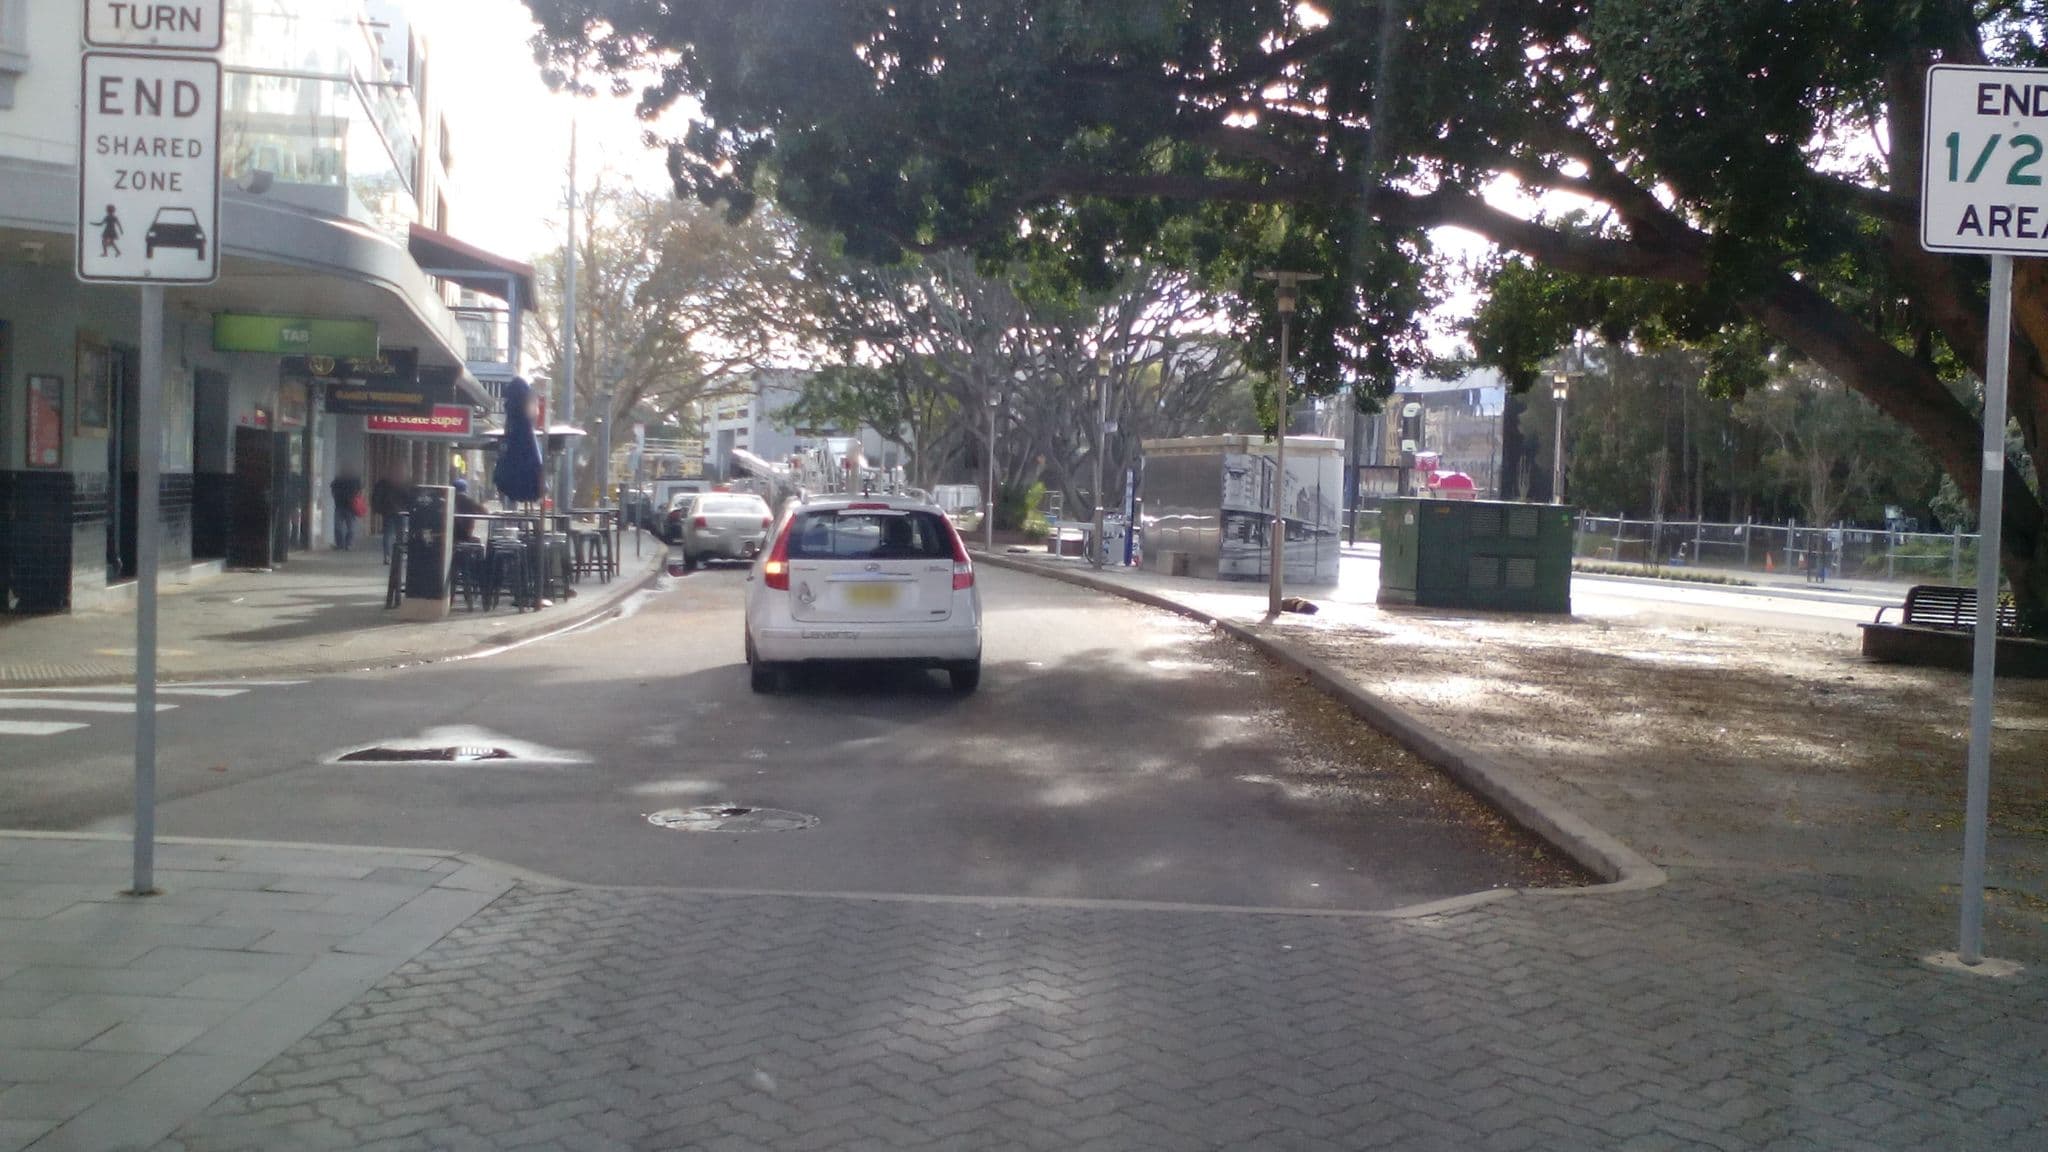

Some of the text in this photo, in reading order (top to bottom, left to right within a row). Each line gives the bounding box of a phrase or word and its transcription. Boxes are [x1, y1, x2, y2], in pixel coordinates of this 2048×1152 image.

[108, 3, 202, 33] TURN
[98, 75, 201, 118] END
[1977, 82, 2048, 117] END
[96, 135, 202, 158] SHARED
[1945, 131, 2044, 186] 1/2
[113, 169, 183, 192] ZONE
[1956, 203, 2048, 239] ARE
[281, 328, 309, 342] TAB
[374, 415, 399, 423] rst
[431, 416, 463, 428] super
